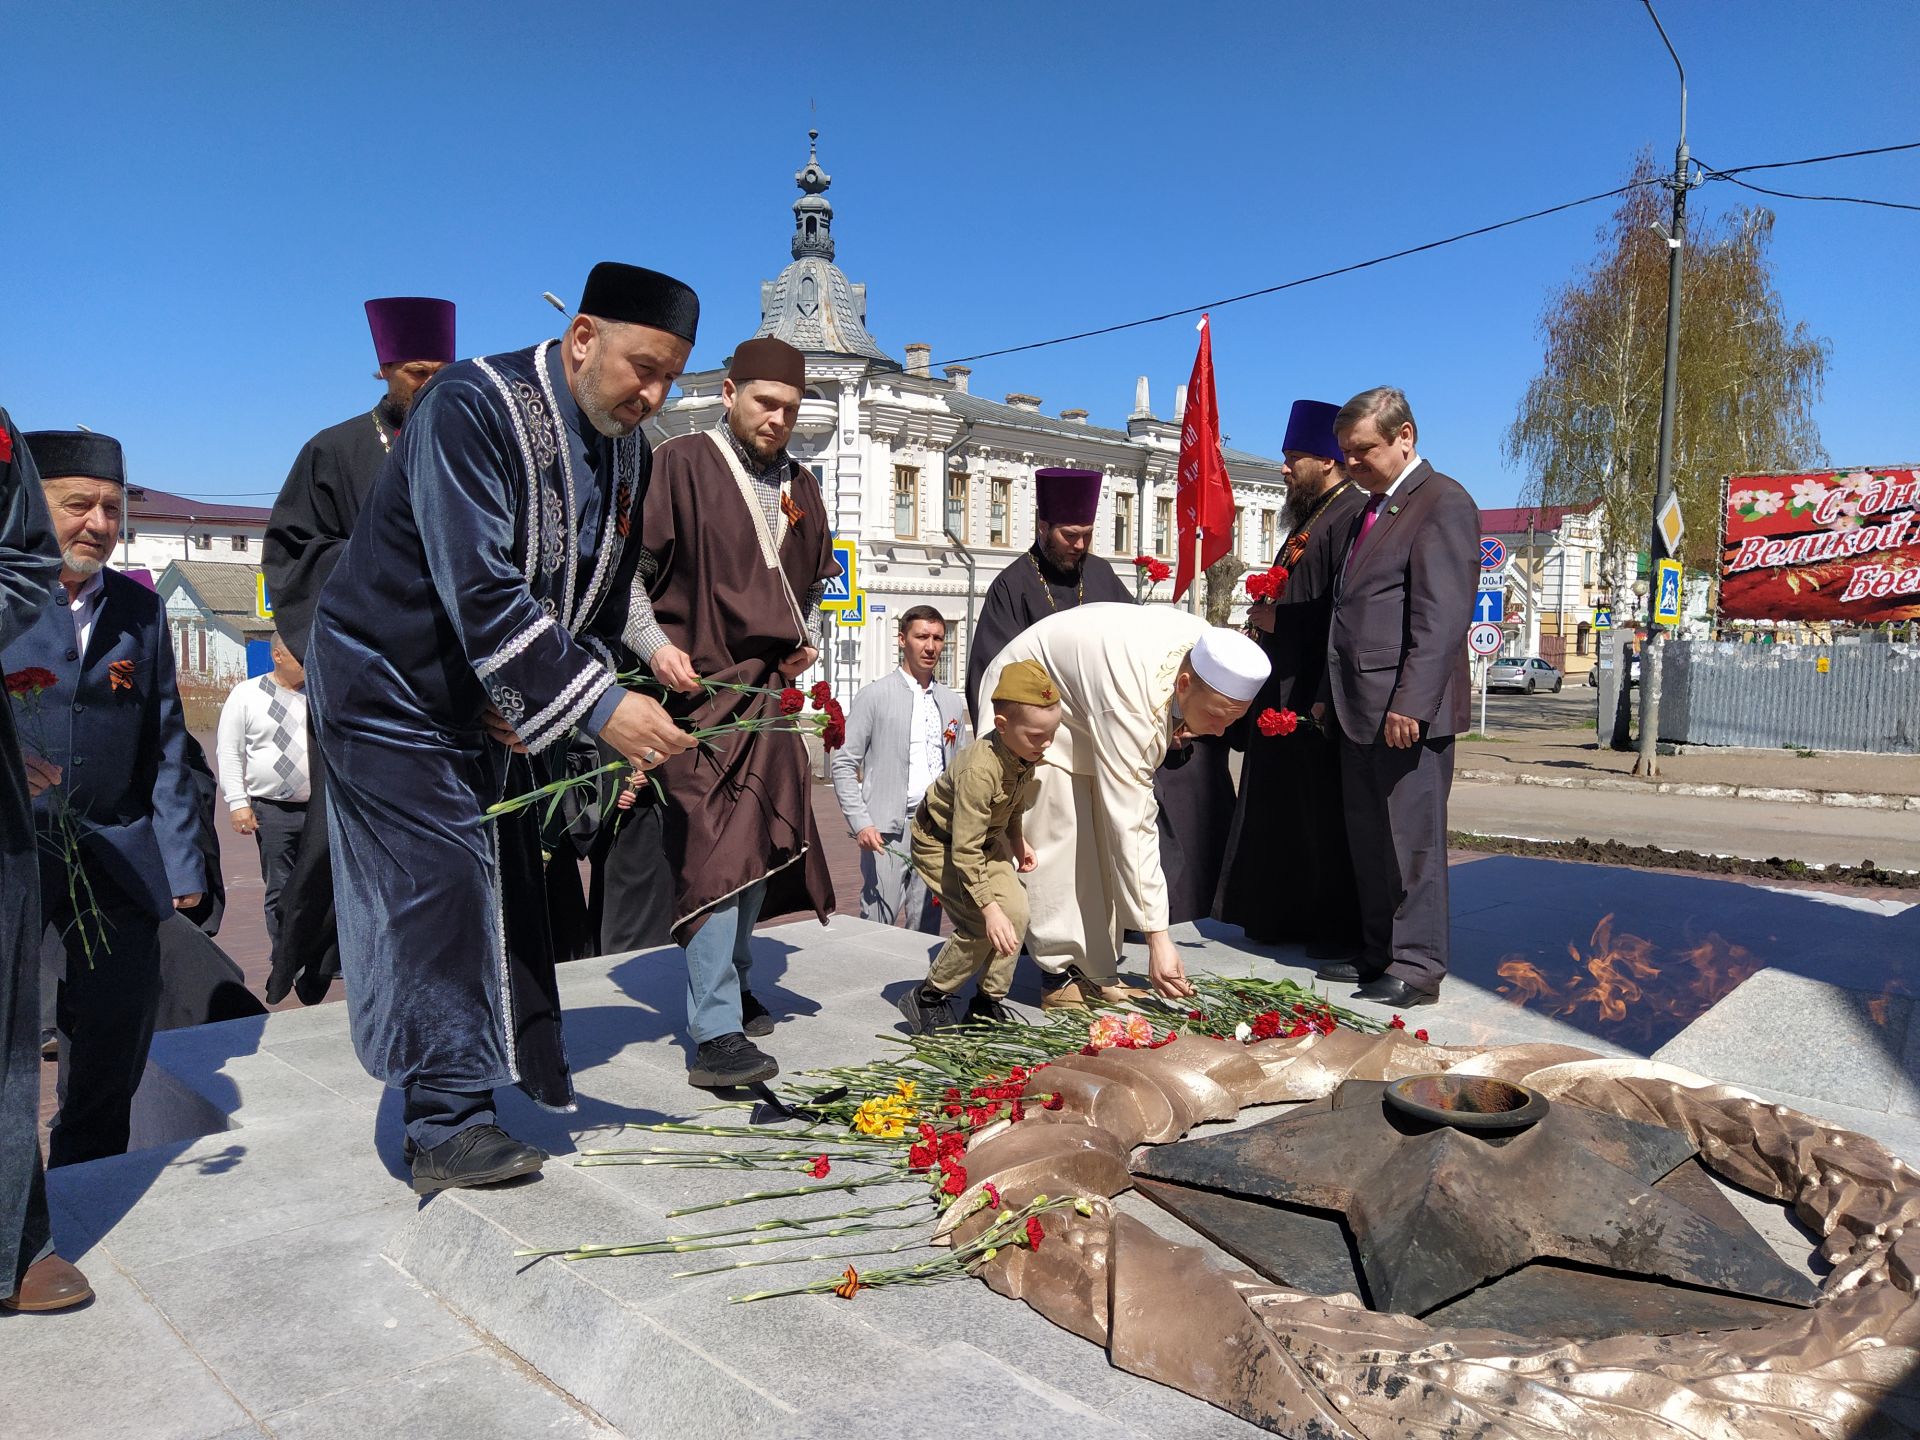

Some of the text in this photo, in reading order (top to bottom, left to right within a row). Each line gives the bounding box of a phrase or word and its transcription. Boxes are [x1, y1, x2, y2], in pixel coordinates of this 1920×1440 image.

[1813, 480, 1920, 524] С дн
[1729, 511, 1915, 572] Великой
[1840, 564, 1920, 602] Бөе
[1476, 633, 1494, 645] 40
